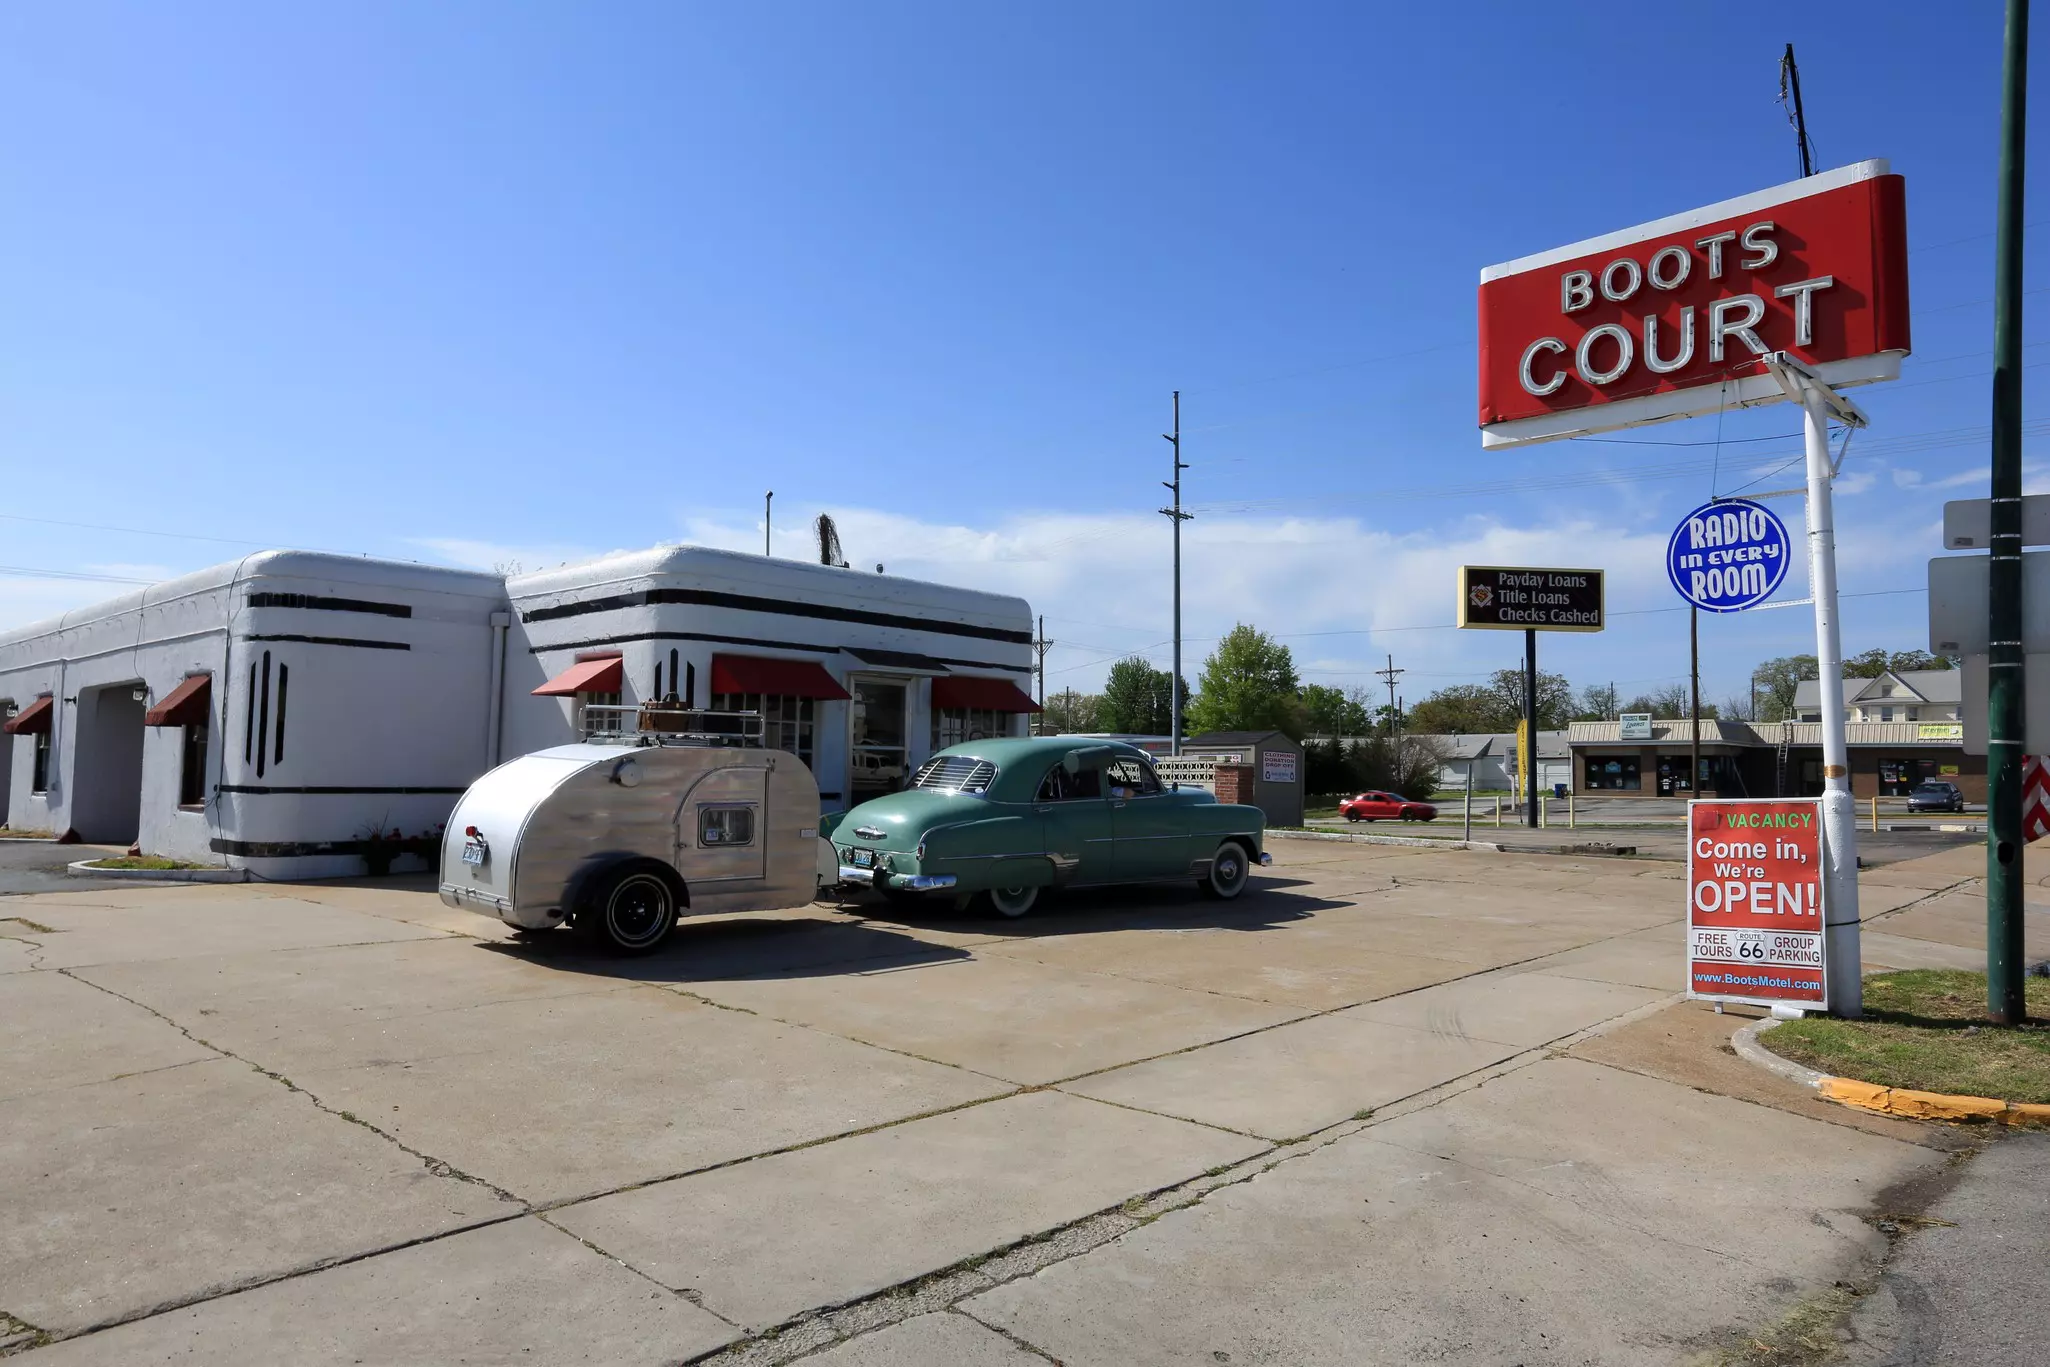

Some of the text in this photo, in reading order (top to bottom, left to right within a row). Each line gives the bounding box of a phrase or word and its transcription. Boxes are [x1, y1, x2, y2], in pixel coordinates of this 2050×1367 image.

[1561, 220, 1778, 314] BOOTS
[1518, 274, 1834, 397] COURT
[1689, 509, 1767, 549] RADIO
[1498, 572, 1587, 588] Payday Loans
[1691, 563, 1767, 602] ROOM
[1498, 590, 1570, 605] Title Loans
[1498, 607, 1599, 623] Checks Cashed
[1727, 813, 1811, 828] VACANCY
[1696, 837, 1807, 863] Come in,
[1713, 863, 1765, 878] We're
[1694, 880, 1816, 915] OPEN!
[1697, 933, 1728, 945] FREE
[1739, 932, 1761, 940] ROUTE
[1774, 936, 1815, 949] GROUP
[1693, 944, 1733, 957] TOURS
[1739, 941, 1764, 959] 66
[1769, 949, 1820, 963] PARKING
[1694, 972, 1821, 990] www.BootsMotel.com
